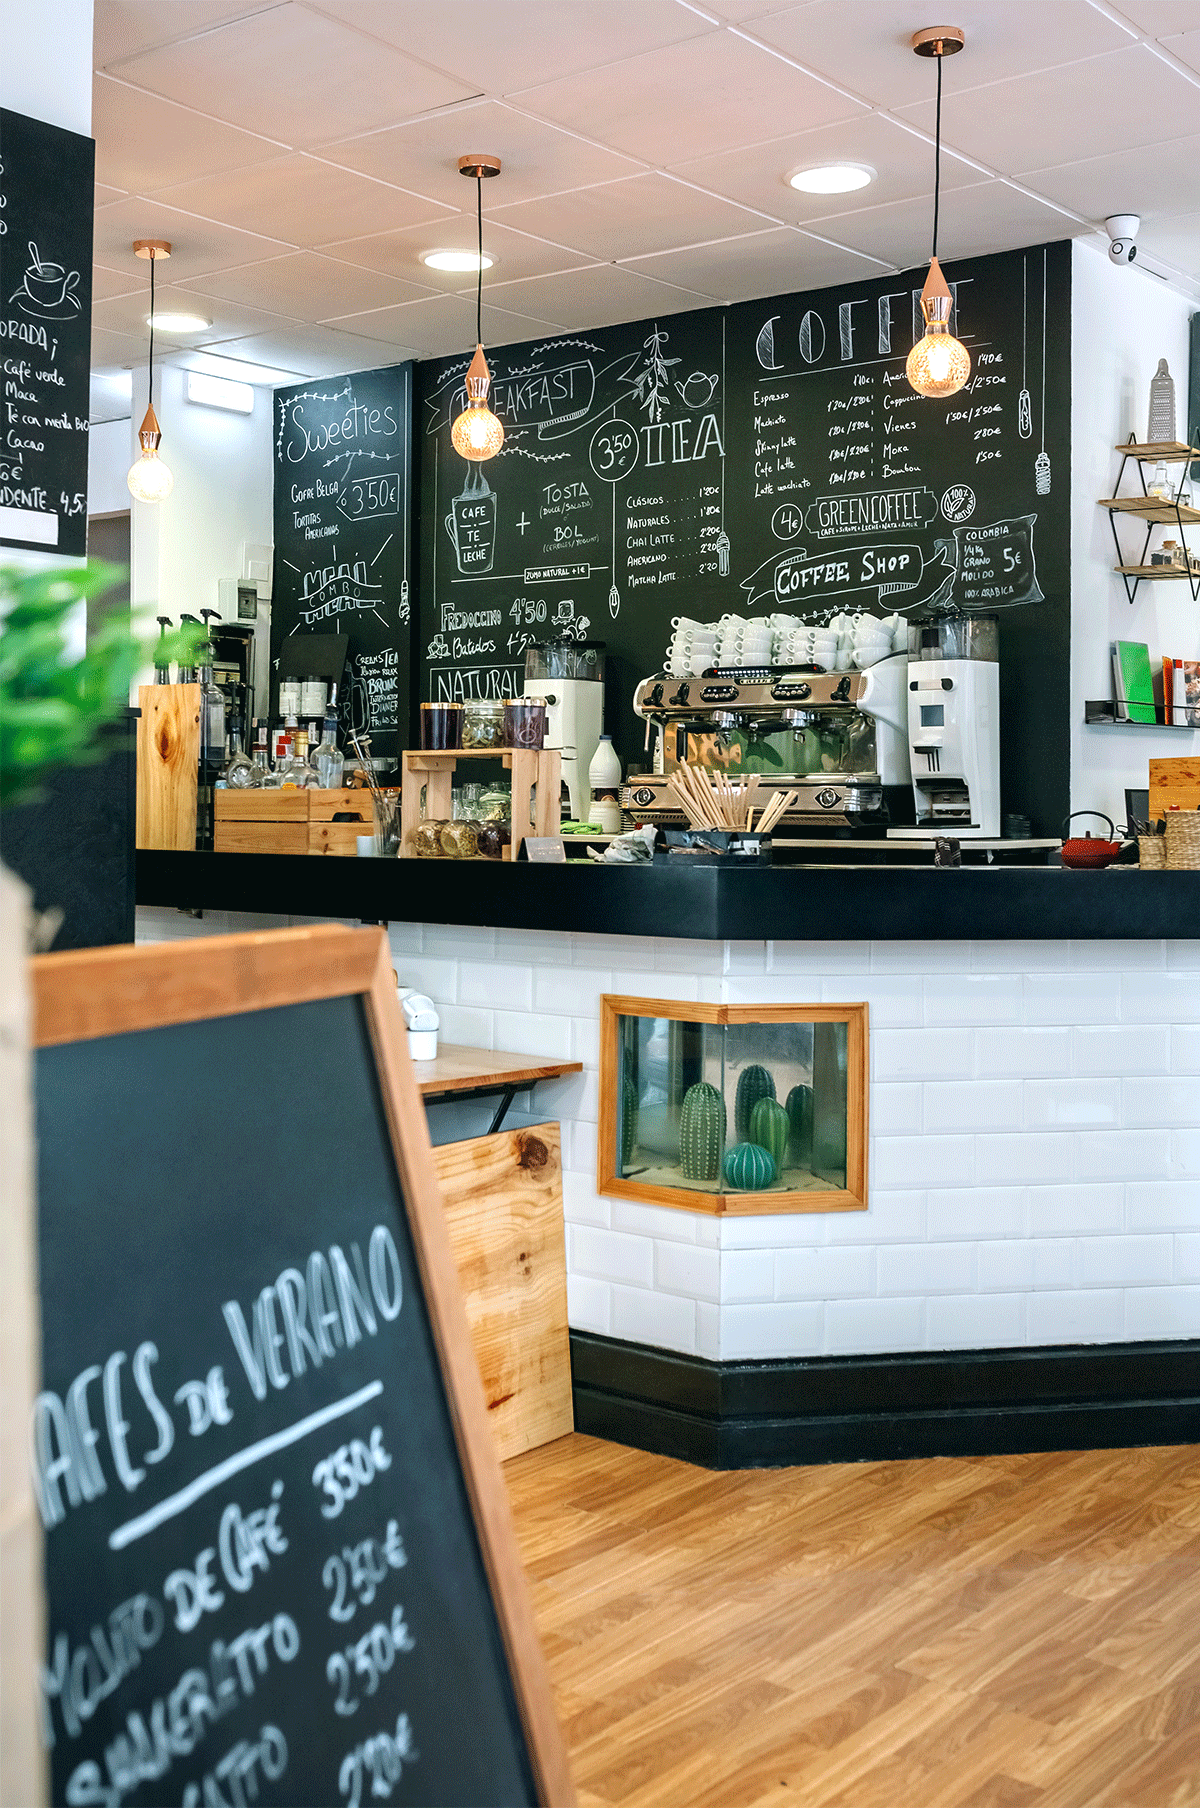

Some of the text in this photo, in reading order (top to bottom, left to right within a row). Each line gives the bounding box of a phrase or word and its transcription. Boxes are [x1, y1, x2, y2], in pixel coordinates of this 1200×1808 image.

[756, 279, 975, 370] COFFE
[36, 368, 66, 386] verde
[754, 391, 789, 407] Espresso
[287, 397, 397, 463] Sweeties
[884, 415, 917, 434] Vienes
[7, 429, 45, 452] Cacao
[640, 414, 726, 467] TEA
[316, 479, 339, 498] BELGA
[542, 481, 590, 504] TOSTA
[293, 511, 322, 529] TORTITAS
[462, 506, 486, 519] CAFE
[627, 515, 670, 529] NATURALES
[467, 530, 480, 542] TE
[554, 525, 582, 542] BOL
[626, 536, 647, 549] CHAI
[650, 534, 675, 547] LATTE
[966, 525, 1010, 541] COLOMBIA
[463, 549, 486, 563] LECHE
[627, 554, 667, 567] AMERICANO
[963, 557, 991, 569] GRANO
[526, 571, 542, 580] ZUMO
[542, 568, 570, 578] NATURAL
[628, 574, 657, 588] MATCHA
[658, 570, 677, 584] LATTE
[777, 551, 910, 594] COFFEE SHOP
[309, 581, 361, 607] COMBO
[981, 585, 1015, 598] ARABICA
[509, 597, 548, 626] 4'50
[452, 637, 497, 659] Batidos
[222, 1224, 402, 1400] VERANO
[164, 1547, 226, 1632] DE
